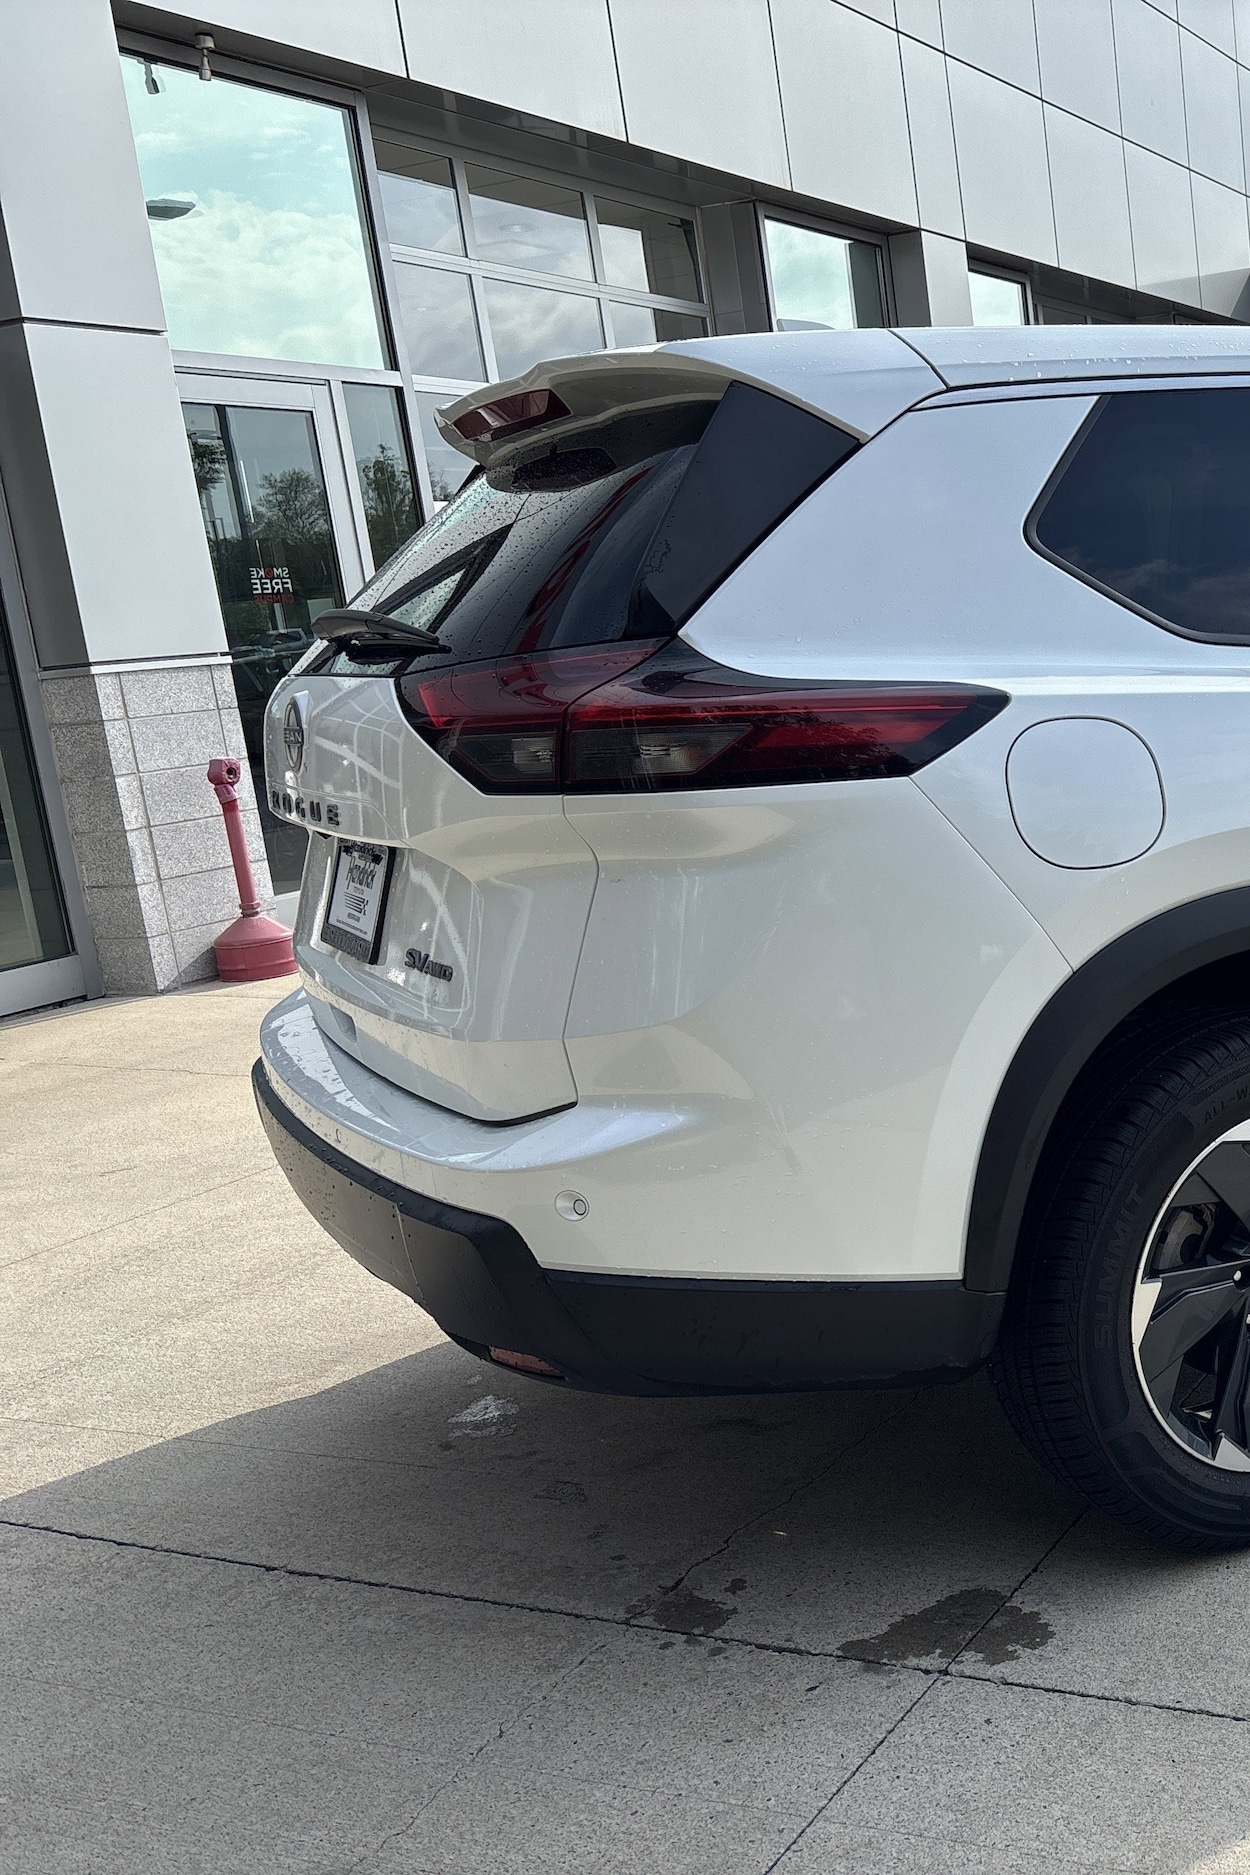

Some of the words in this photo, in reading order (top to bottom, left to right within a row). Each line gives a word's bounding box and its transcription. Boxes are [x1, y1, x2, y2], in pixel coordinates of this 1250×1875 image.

[271, 789, 340, 826] ROGUE
[404, 947, 430, 973] SV
[1092, 1181, 1146, 1350] SUMMIT
